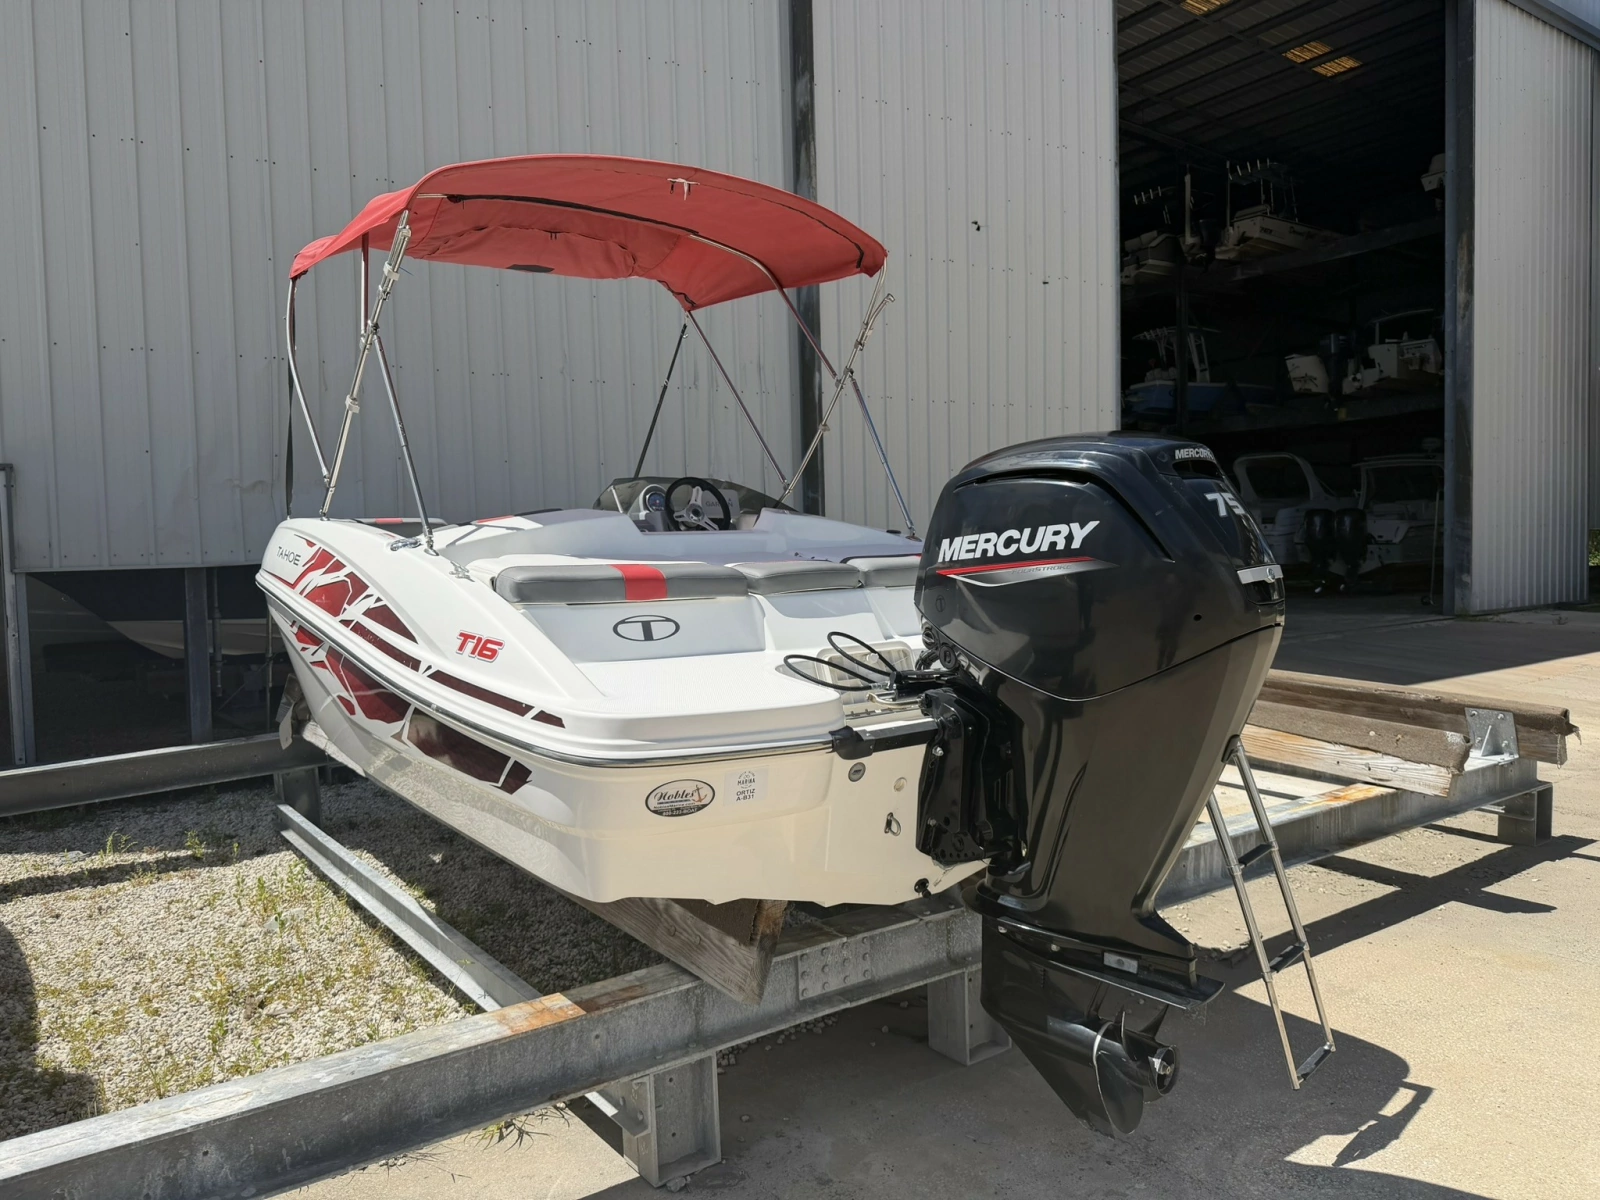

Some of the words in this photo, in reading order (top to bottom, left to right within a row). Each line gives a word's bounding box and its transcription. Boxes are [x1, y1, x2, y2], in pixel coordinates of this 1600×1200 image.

[705, 500, 733, 508] GARN
[1204, 492, 1245, 518] 75
[938, 520, 1100, 563] MERCURY
[276, 545, 301, 566] TAHOE
[456, 630, 505, 663] T16
[653, 789, 696, 802] Nobles
[736, 788, 755, 796] ORTIZ
